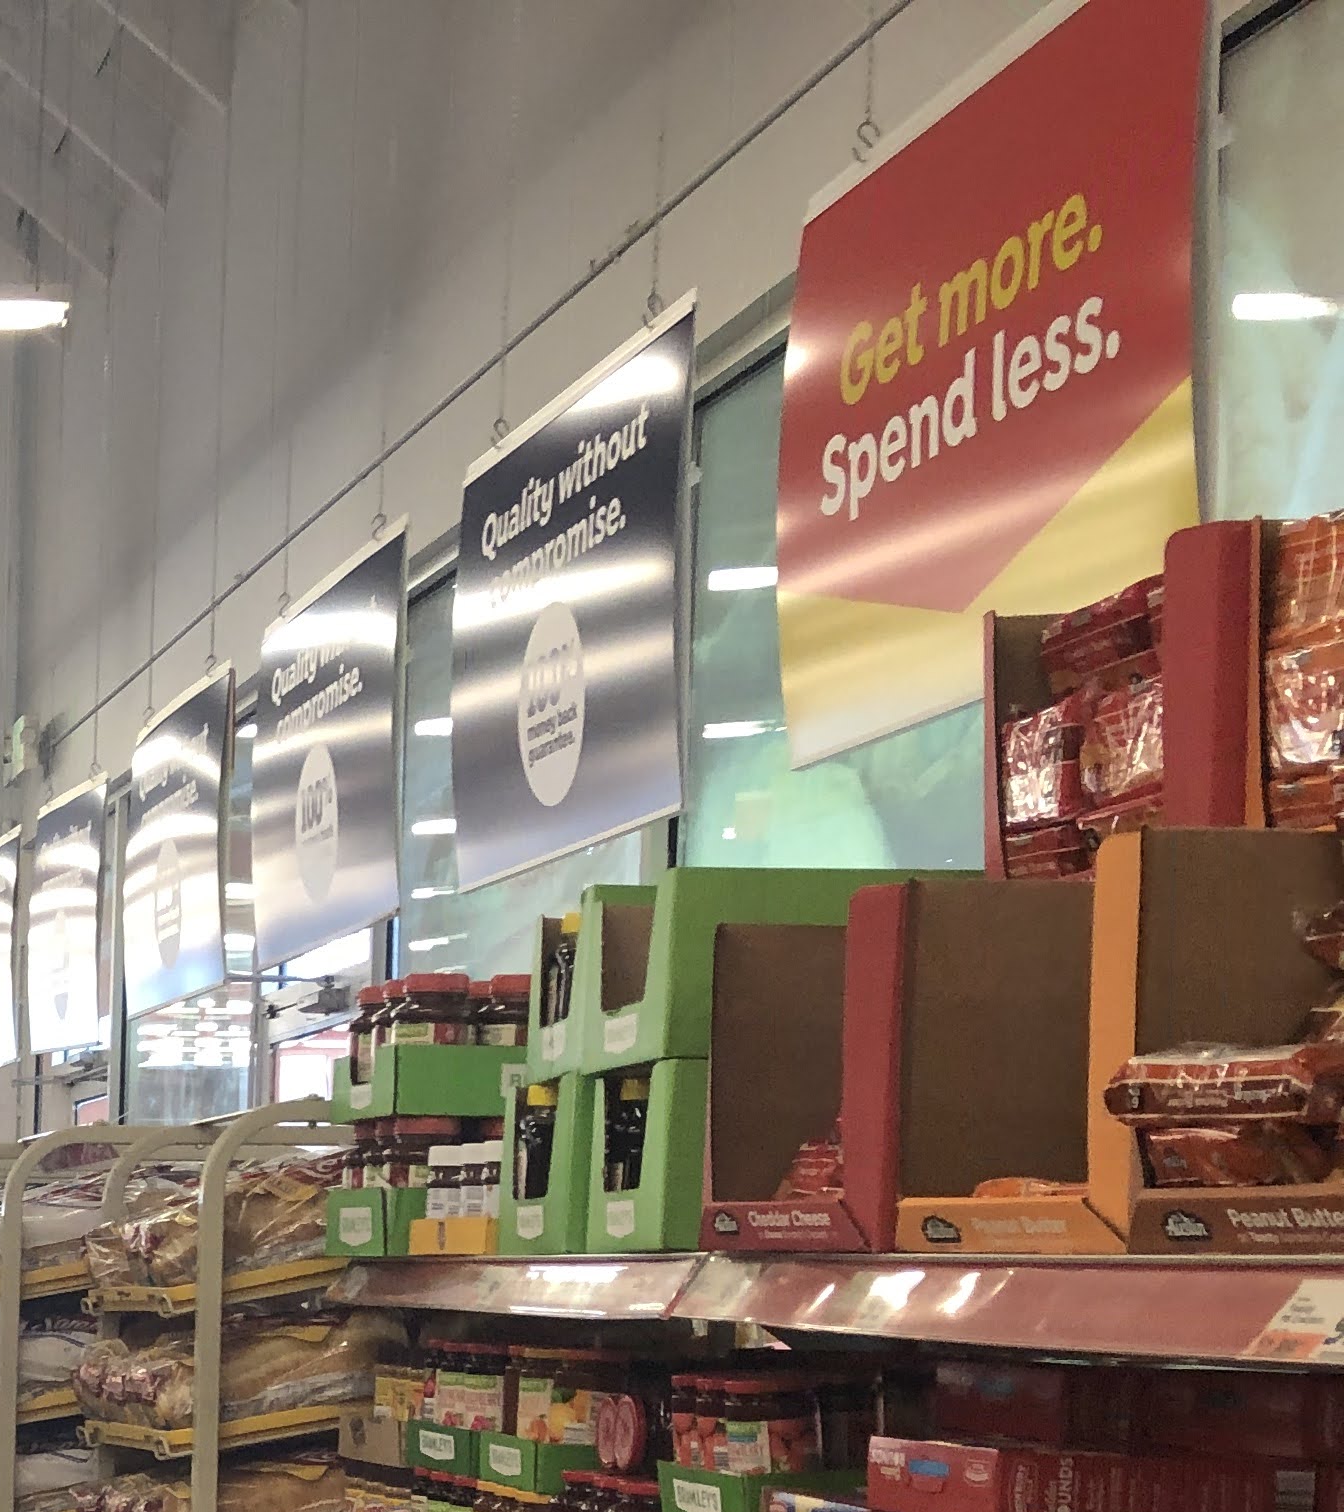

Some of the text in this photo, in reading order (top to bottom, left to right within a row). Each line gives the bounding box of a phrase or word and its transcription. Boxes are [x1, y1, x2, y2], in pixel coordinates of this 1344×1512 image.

[840, 193, 1102, 405] Get more.
[821, 297, 1120, 521] Spend less.
[481, 402, 649, 561] Quality without
[271, 646, 317, 707] Quality
[792, 1211, 831, 1227] Cheese
[1227, 1208, 1293, 1228] Peanut
[1291, 1207, 1344, 1227] Butte
